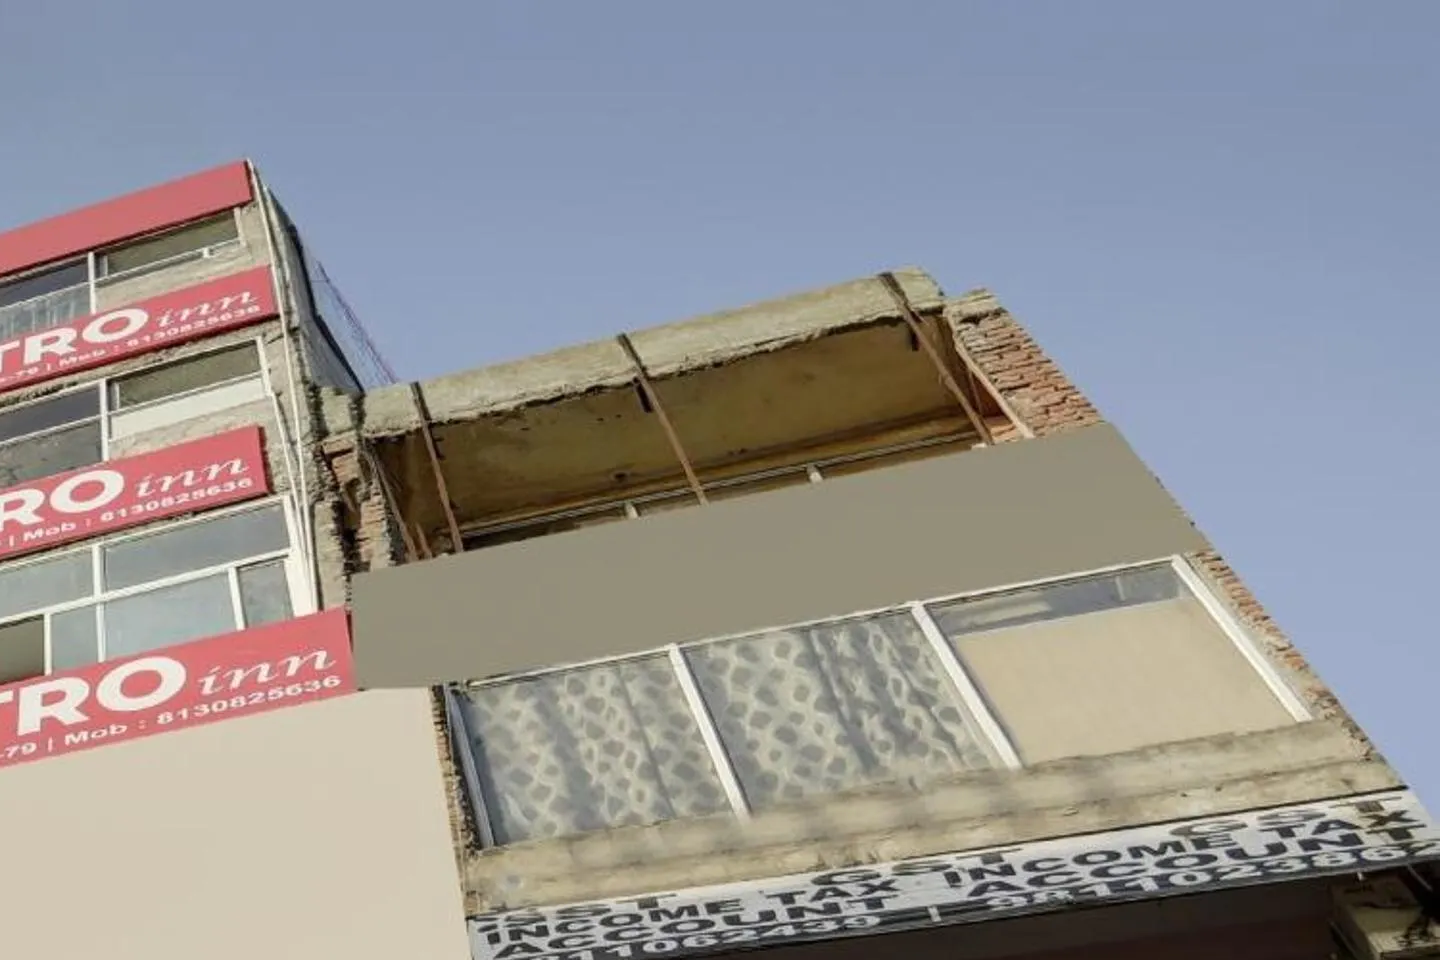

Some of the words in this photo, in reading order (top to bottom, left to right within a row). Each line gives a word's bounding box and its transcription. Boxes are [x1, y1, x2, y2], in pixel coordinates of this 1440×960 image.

[157, 291, 262, 328] inn
[137, 457, 250, 498] inn
[23, 519, 77, 543] Mob
[198, 646, 337, 696] inn
[64, 721, 127, 747] Mob
[157, 674, 341, 725] 8130825636
[1169, 797, 1404, 836] GST
[812, 848, 1022, 886] GST
[944, 836, 1236, 888] INCOME
[1262, 810, 1419, 838] TAX
[968, 824, 1426, 897] ACCOUNT
[488, 898, 744, 944] INCOME
[765, 879, 901, 905] TAX
[493, 896, 899, 960] ACCOUNT
